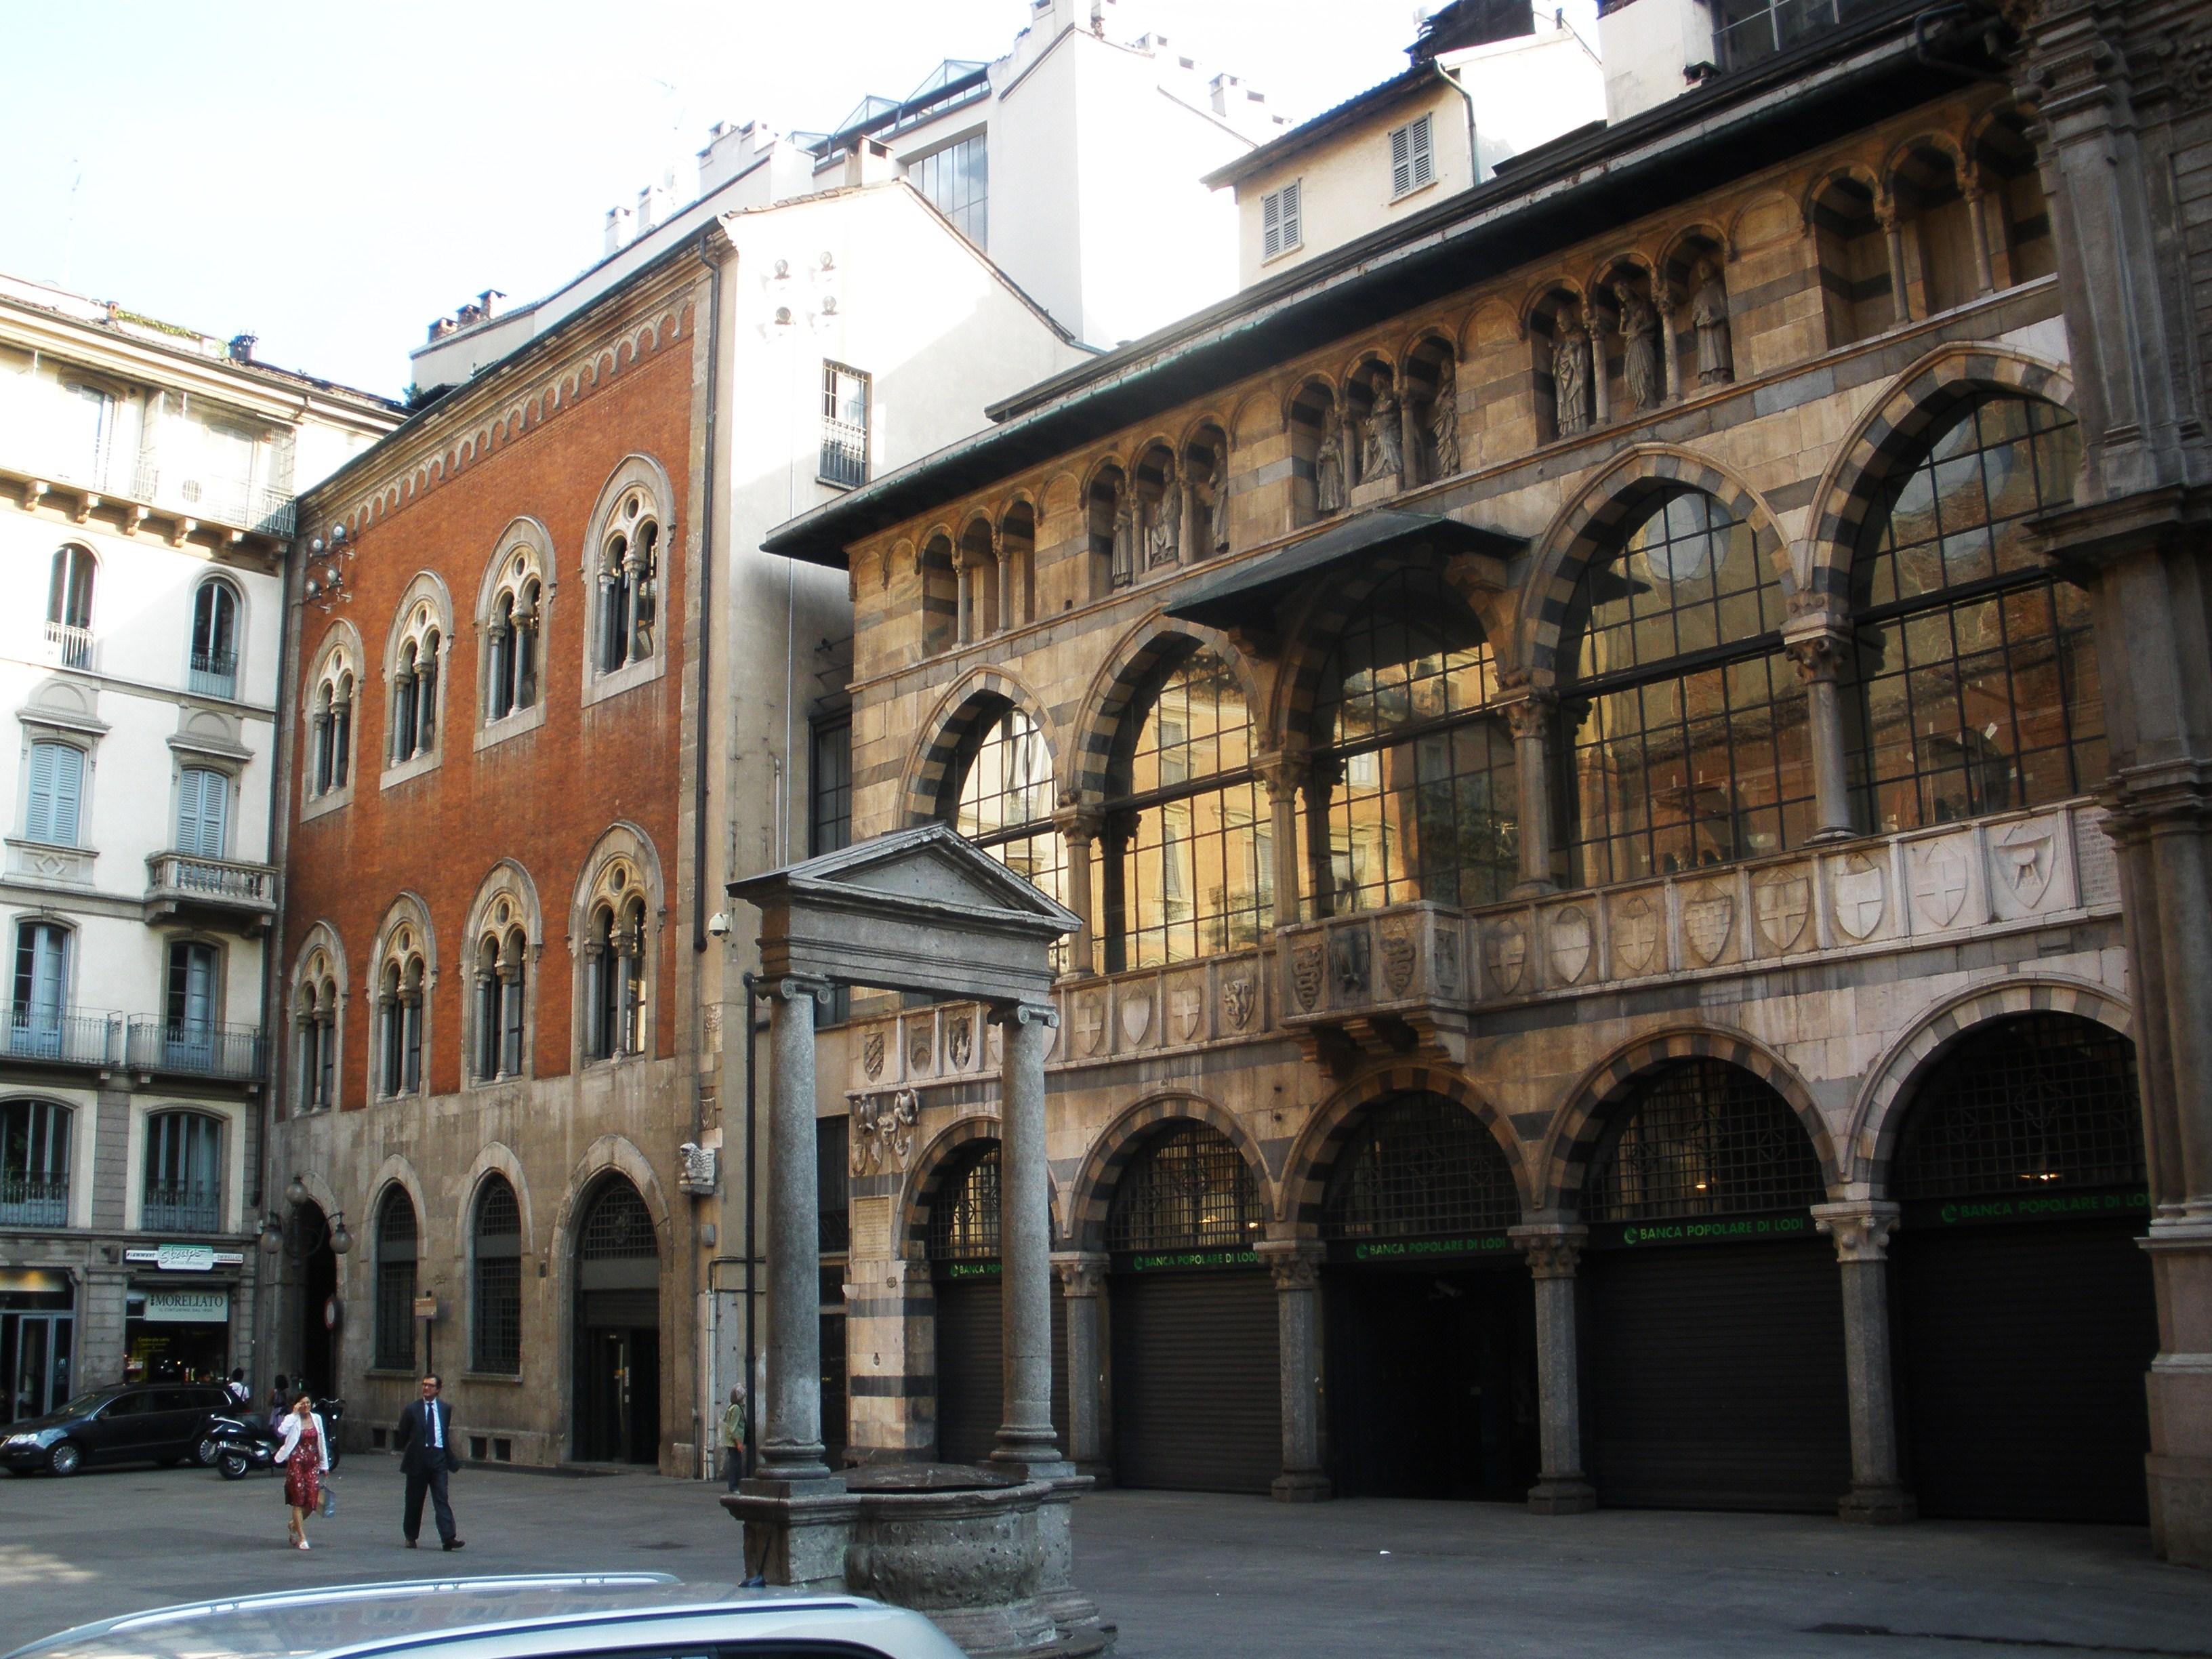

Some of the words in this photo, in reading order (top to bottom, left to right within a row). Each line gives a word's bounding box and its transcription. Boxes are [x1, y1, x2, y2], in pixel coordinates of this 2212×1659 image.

[1961, 1203, 2012, 1218] BANCA
[2018, 1195, 2100, 1214] POPOLARE
[2104, 1194, 2120, 1208] DI
[1639, 1226, 1682, 1240] BANCA
[1687, 1221, 1752, 1236] POPOLARE
[1757, 1221, 1769, 1232] DI
[1774, 1218, 1803, 1231] LODI
[1369, 1243, 1405, 1255] BANCA
[1409, 1240, 1464, 1253] POPOLARE
[1467, 1239, 1477, 1250] DI
[1481, 1237, 1506, 1249] LODI
[1145, 1256, 1174, 1267] BANCA
[1177, 1253, 1223, 1265] POPOLARE
[1225, 1253, 1234, 1263] DI
[960, 1265, 985, 1274] BANCA
[156, 1294, 223, 1307] MORELLATO
